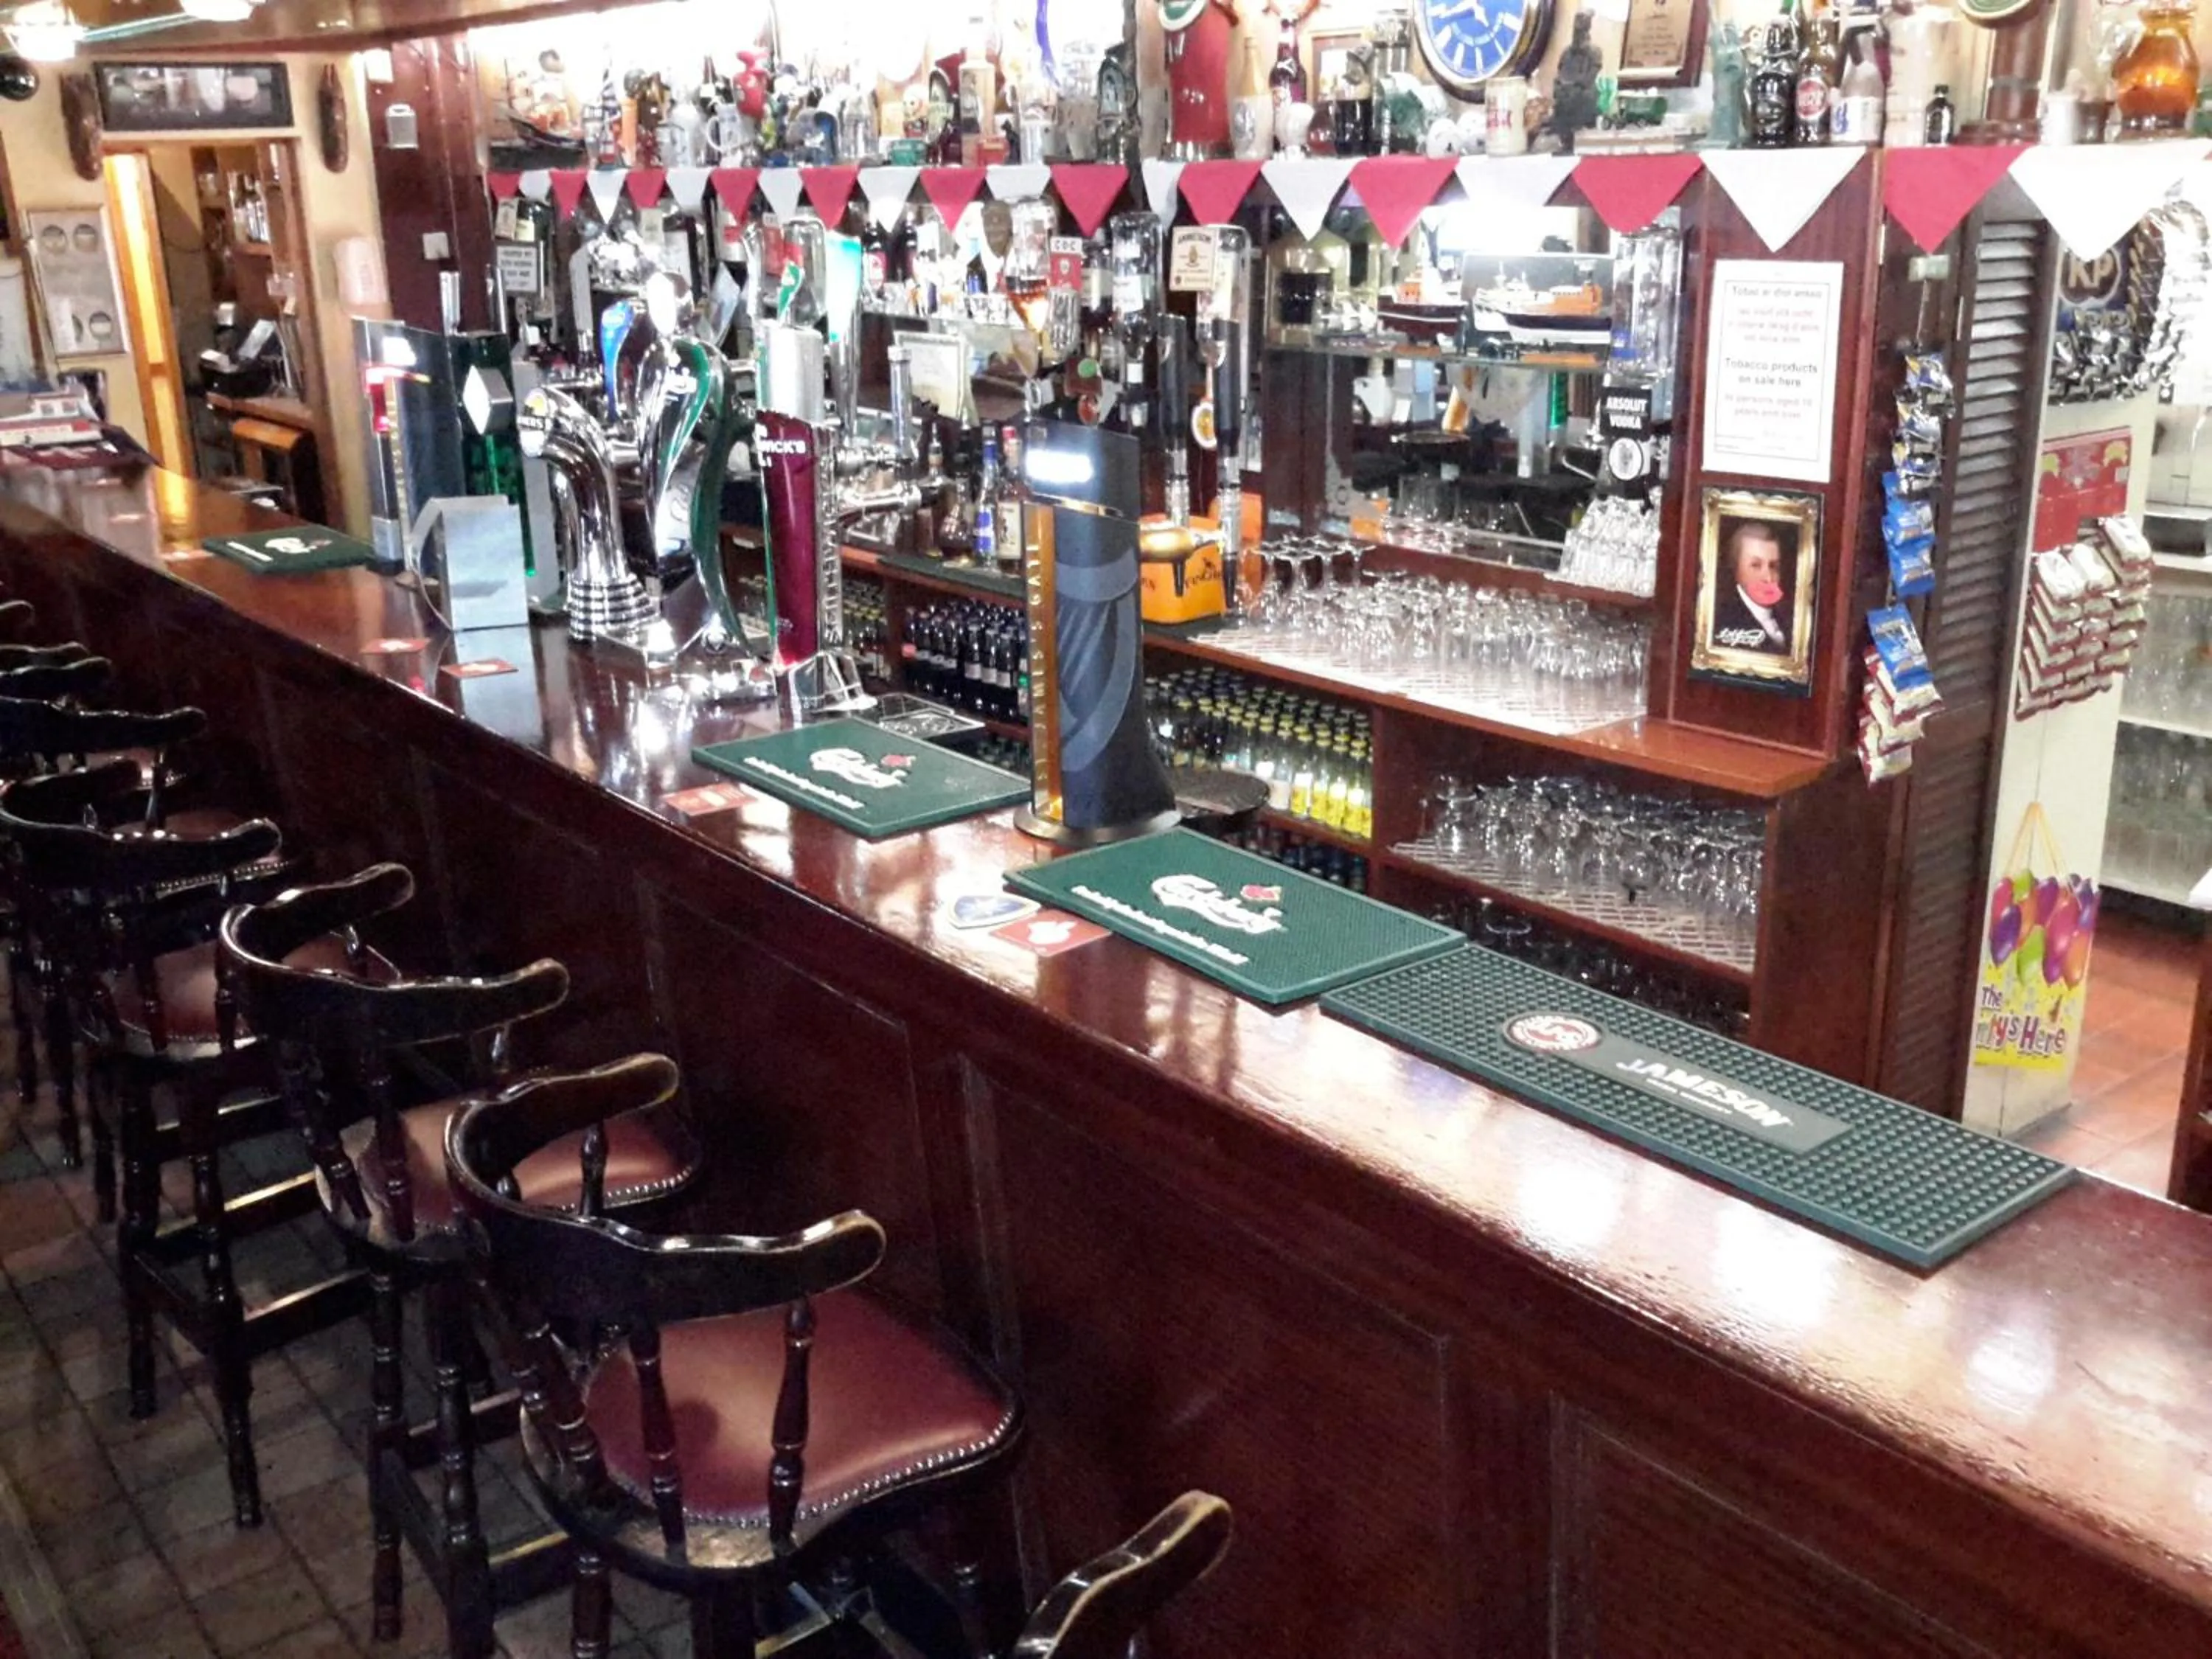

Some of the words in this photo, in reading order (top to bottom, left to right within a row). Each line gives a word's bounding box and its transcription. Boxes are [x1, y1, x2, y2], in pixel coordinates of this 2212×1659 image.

[2067, 251, 2114, 288] KP
[1725, 357, 1768, 370] Tobacco
[1771, 359, 1818, 374] products
[1738, 375, 1751, 383] on
[1755, 375, 1775, 386] sale
[1778, 375, 1802, 387] here
[1606, 396, 1648, 413] ABSOLUT
[1609, 413, 1642, 429] VODKA
[2020, 1015, 2065, 1053] Here
[1615, 1058, 1792, 1127] JAMESON
